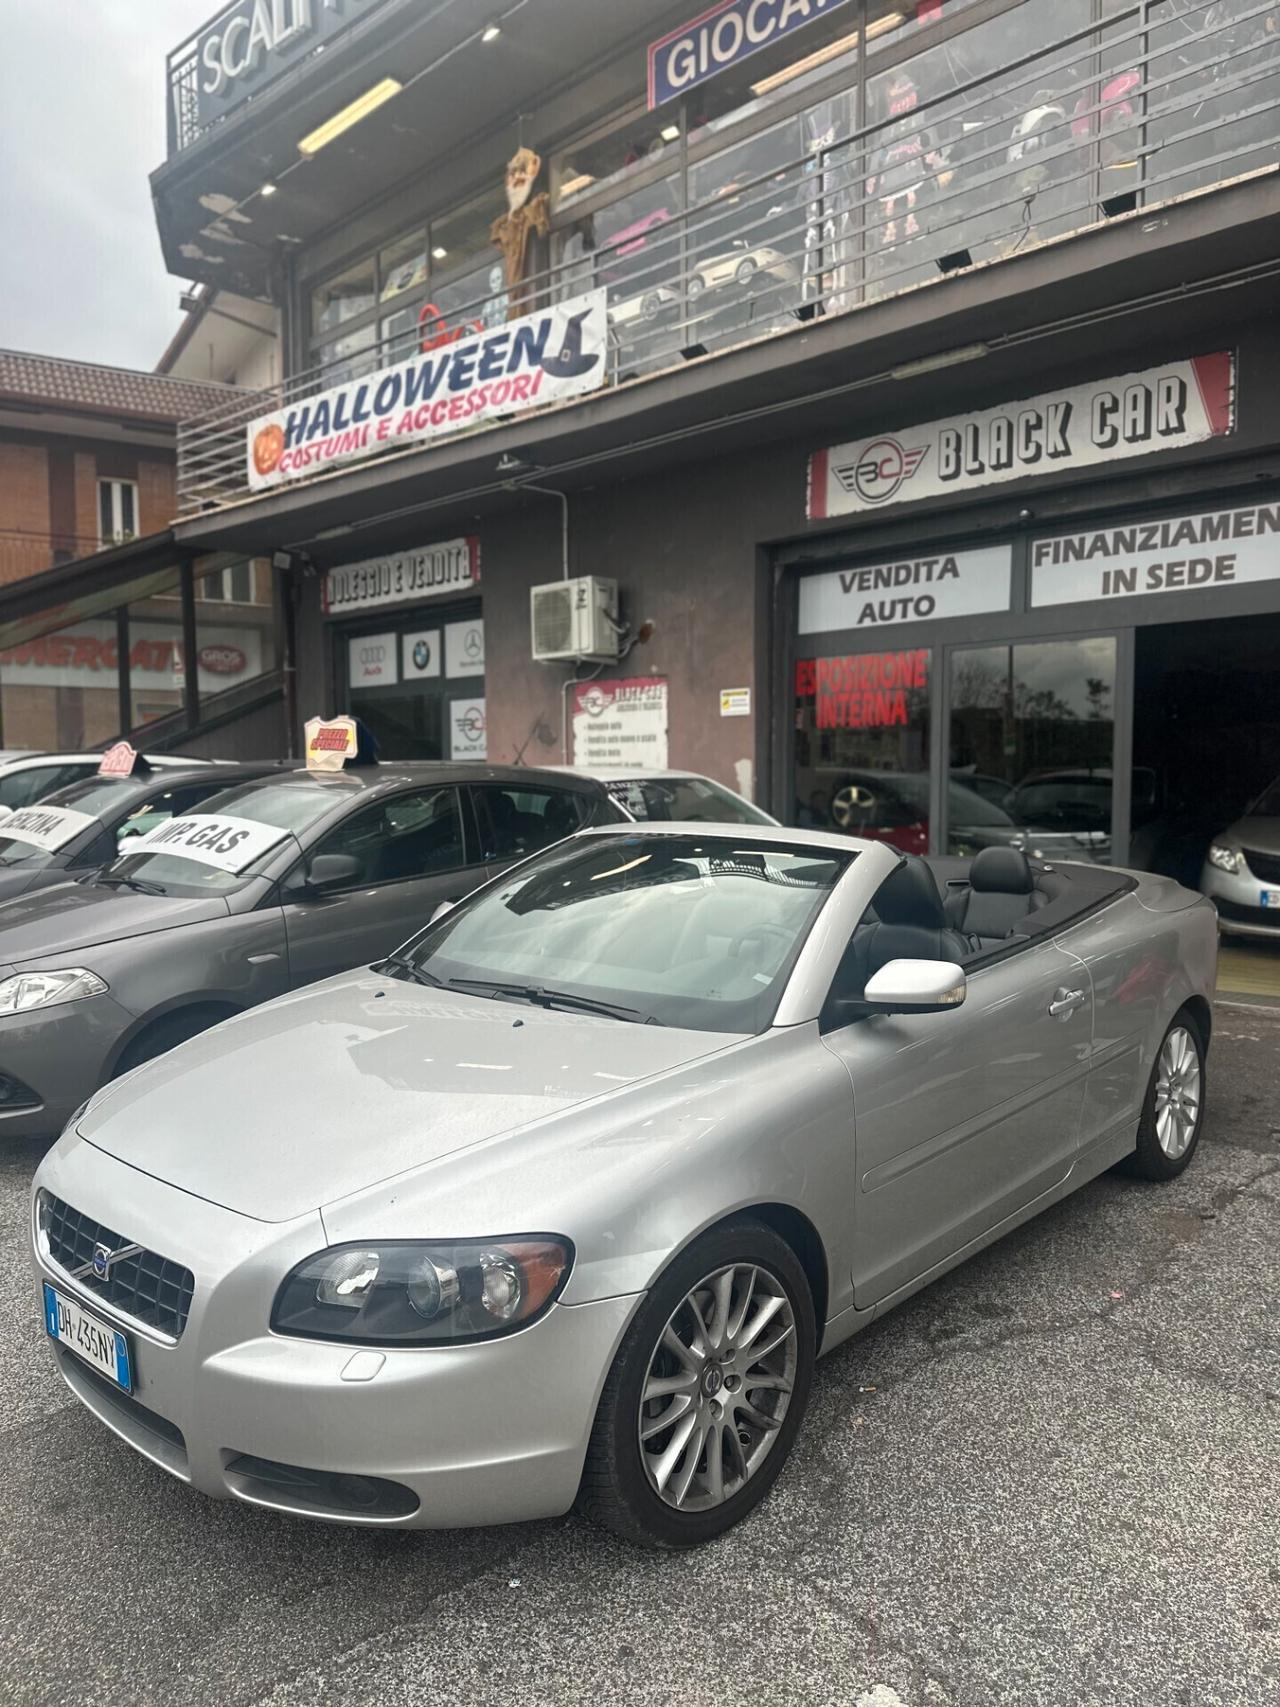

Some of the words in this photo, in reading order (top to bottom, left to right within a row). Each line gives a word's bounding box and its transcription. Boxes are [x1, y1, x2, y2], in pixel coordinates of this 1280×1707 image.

[667, 0, 825, 87] GIOCA
[283, 318, 553, 449] HALLOWEEN
[278, 422, 372, 473] COSTUMI
[376, 416, 393, 441] E
[398, 370, 544, 434] ACCESSORI
[937, 400, 1073, 482] BLACK
[1090, 375, 1188, 449] CAR
[1034, 506, 1280, 567] FINANZIAMEN
[394, 560, 403, 593] E
[405, 544, 472, 590] VENDITA
[838, 557, 960, 594] VENDITA
[1101, 567, 1138, 596] IN
[1146, 553, 1237, 590] SEDE
[856, 594, 936, 625] AUTO
[795, 647, 929, 697] ESPOSIZIONE
[815, 689, 908, 729] INTERNA
[185, 823, 250, 854] GAS
[57, 1300, 73, 1341] DH
[77, 1316, 115, 1369] 435NY
